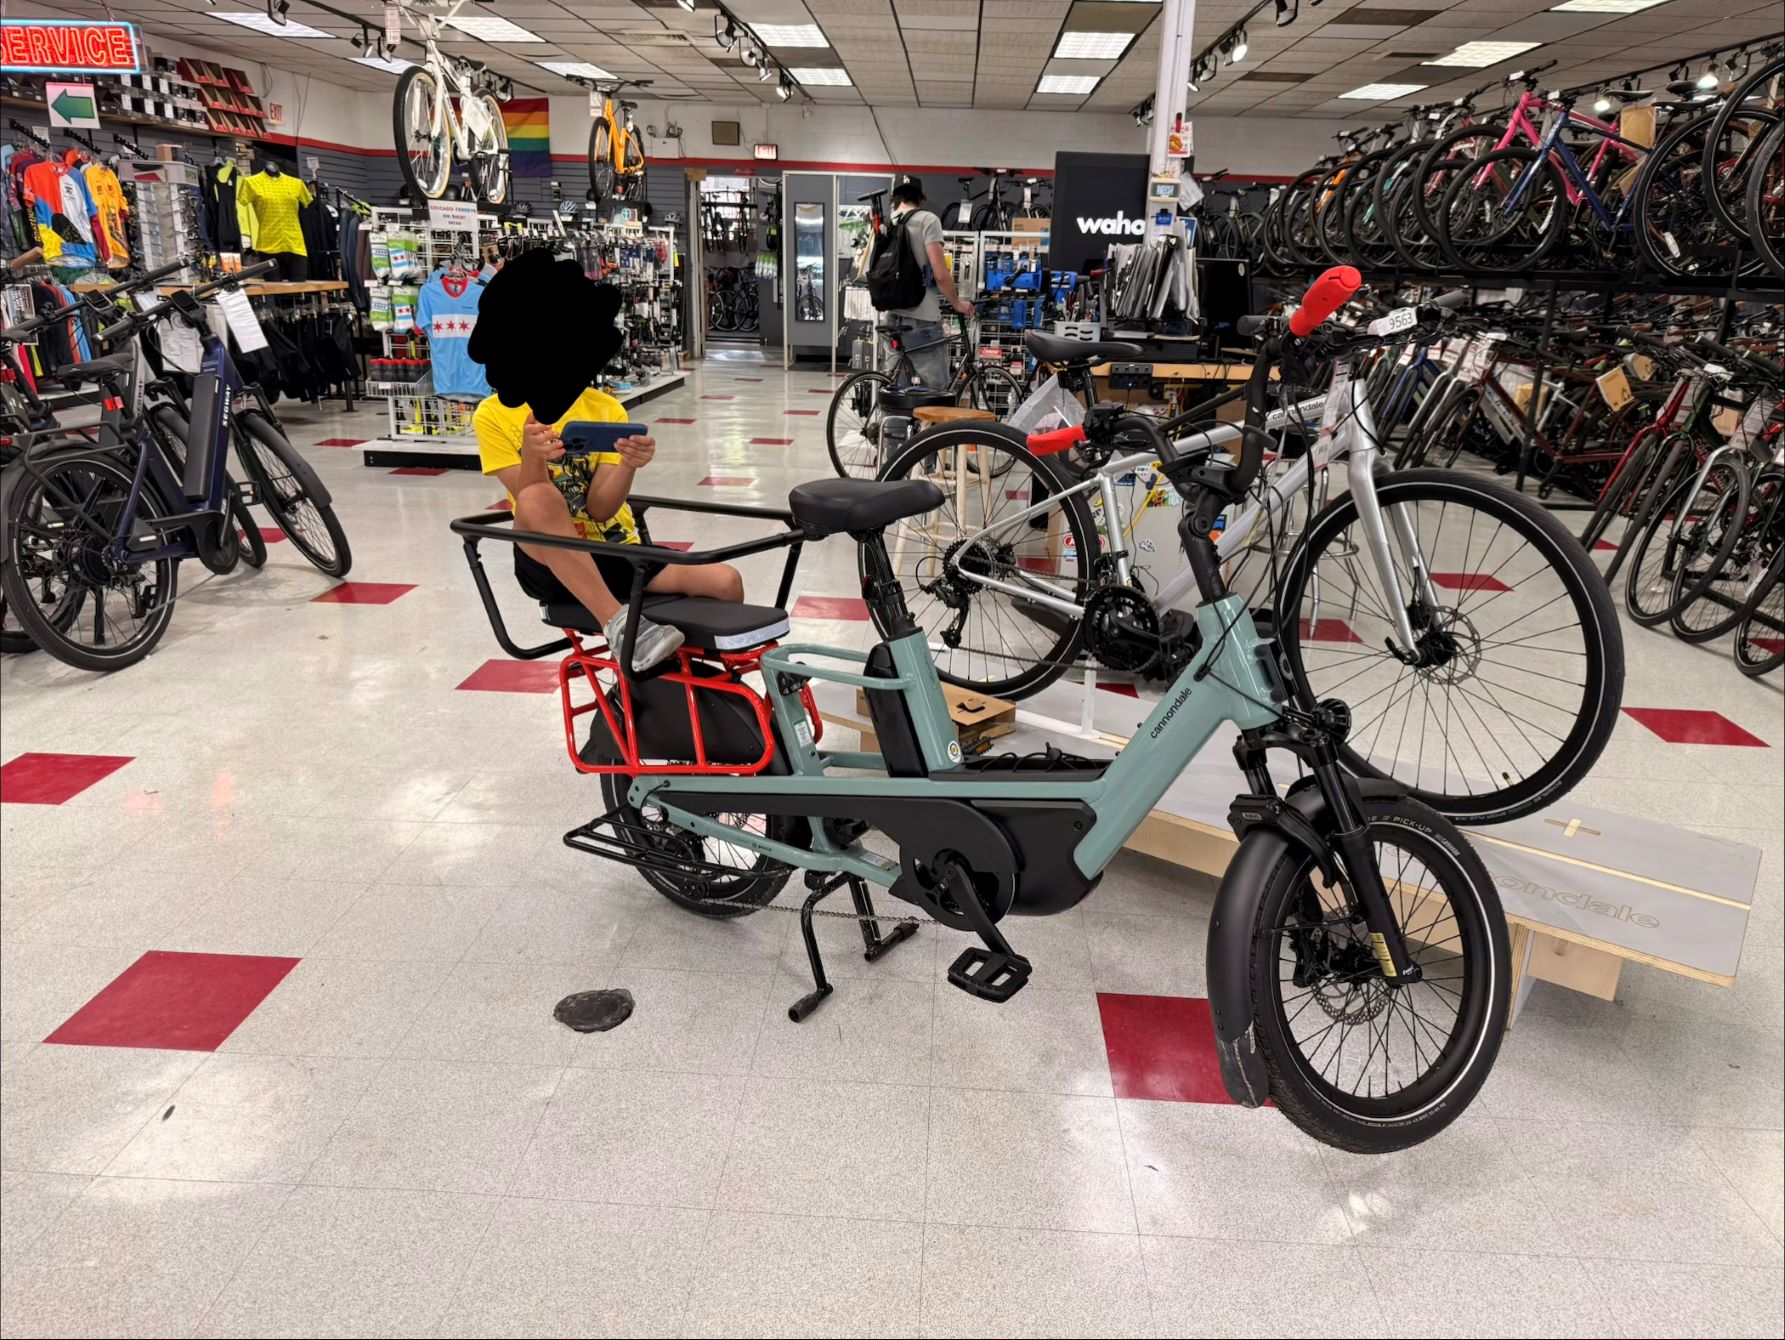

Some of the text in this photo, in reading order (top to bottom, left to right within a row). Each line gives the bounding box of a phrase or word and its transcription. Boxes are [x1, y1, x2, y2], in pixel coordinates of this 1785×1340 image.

[1077, 210, 1146, 235] waho
[1389, 312, 1413, 330] 9563
[222, 384, 231, 427] SEGWAY
[1272, 401, 1324, 420] canndale
[1150, 687, 1192, 739] cannondale
